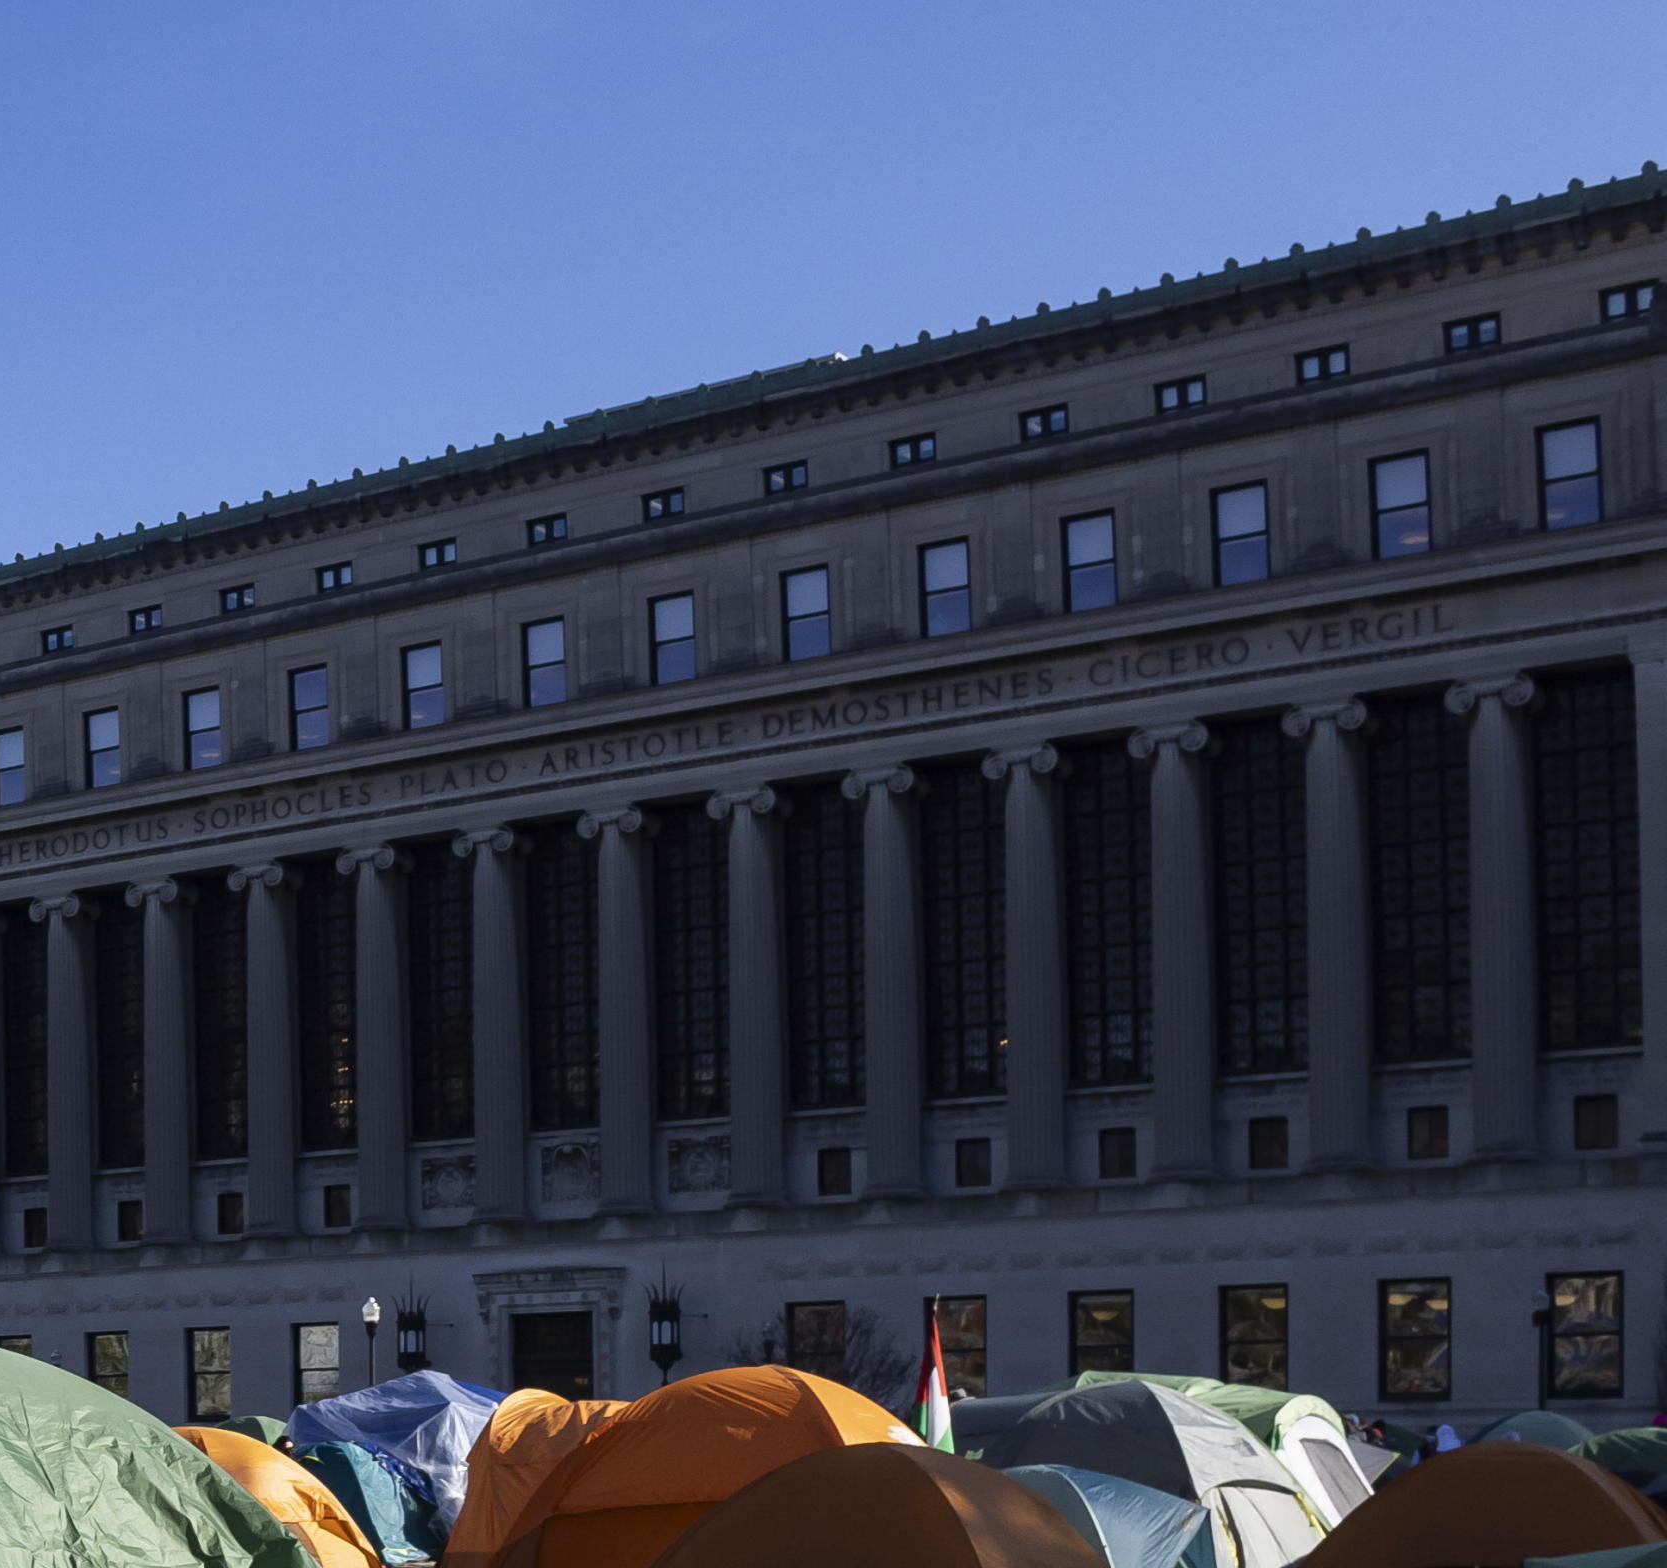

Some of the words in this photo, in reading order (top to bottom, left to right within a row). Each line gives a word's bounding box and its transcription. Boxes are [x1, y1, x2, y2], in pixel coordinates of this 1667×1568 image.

[192, 781, 373, 833] SOPHOCLES
[399, 758, 509, 801] PLATO
[538, 719, 735, 777] ARISTOTLE
[760, 667, 1055, 739] DEMOSTHENES
[1088, 637, 1251, 689] CICERO
[1285, 604, 1455, 656] VERGIL
